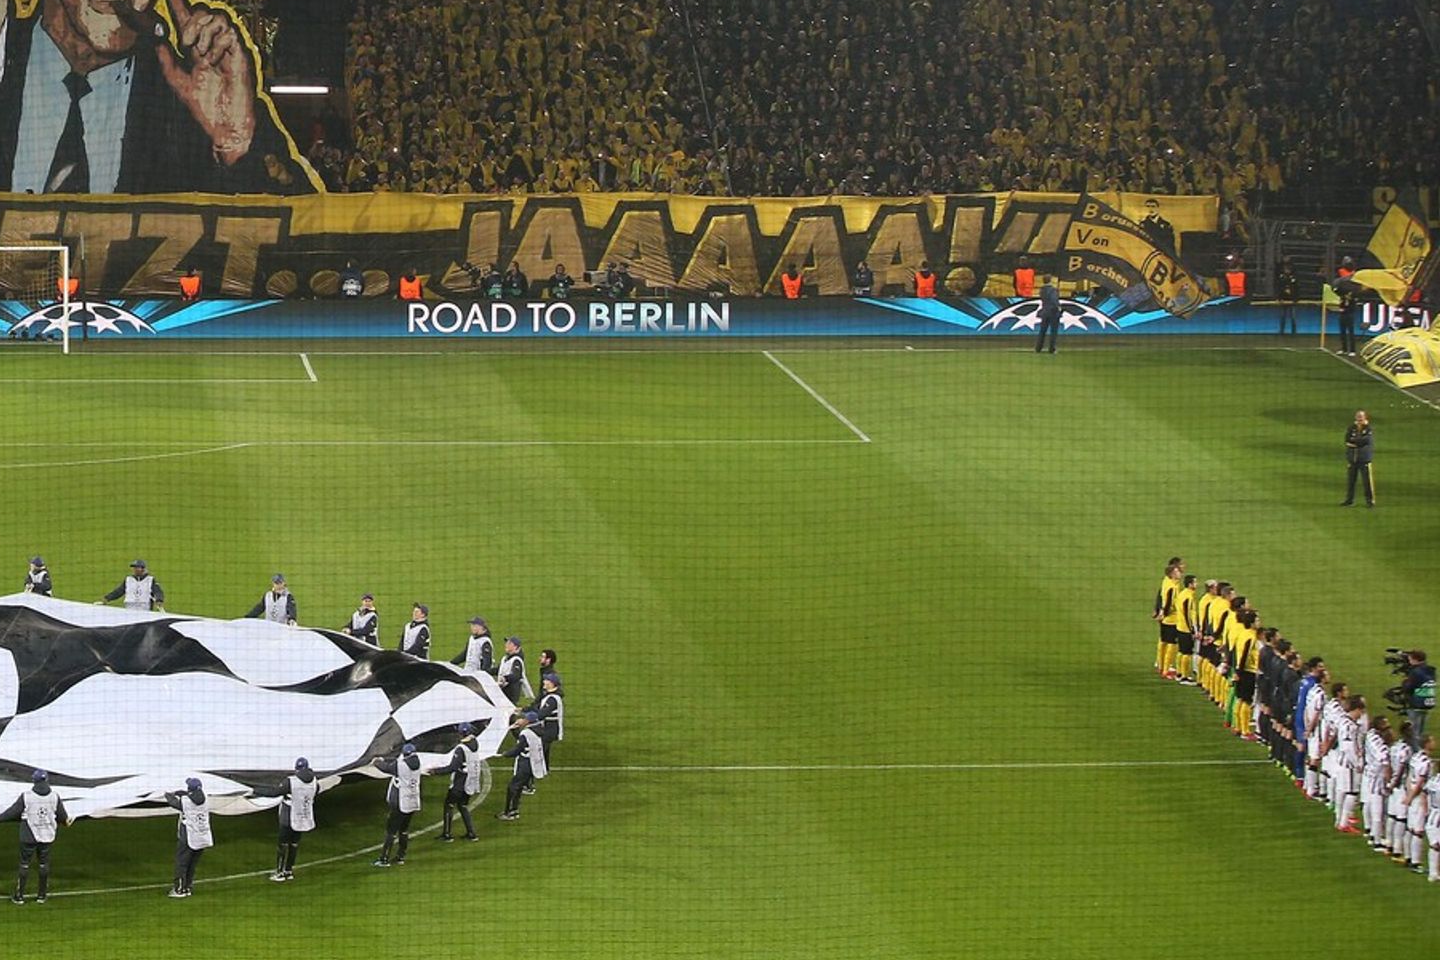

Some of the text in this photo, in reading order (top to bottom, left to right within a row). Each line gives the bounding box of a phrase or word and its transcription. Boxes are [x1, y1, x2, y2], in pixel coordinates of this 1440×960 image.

[1077, 229, 1109, 246] Von
[407, 303, 731, 333] ROAD TO BERLIN
